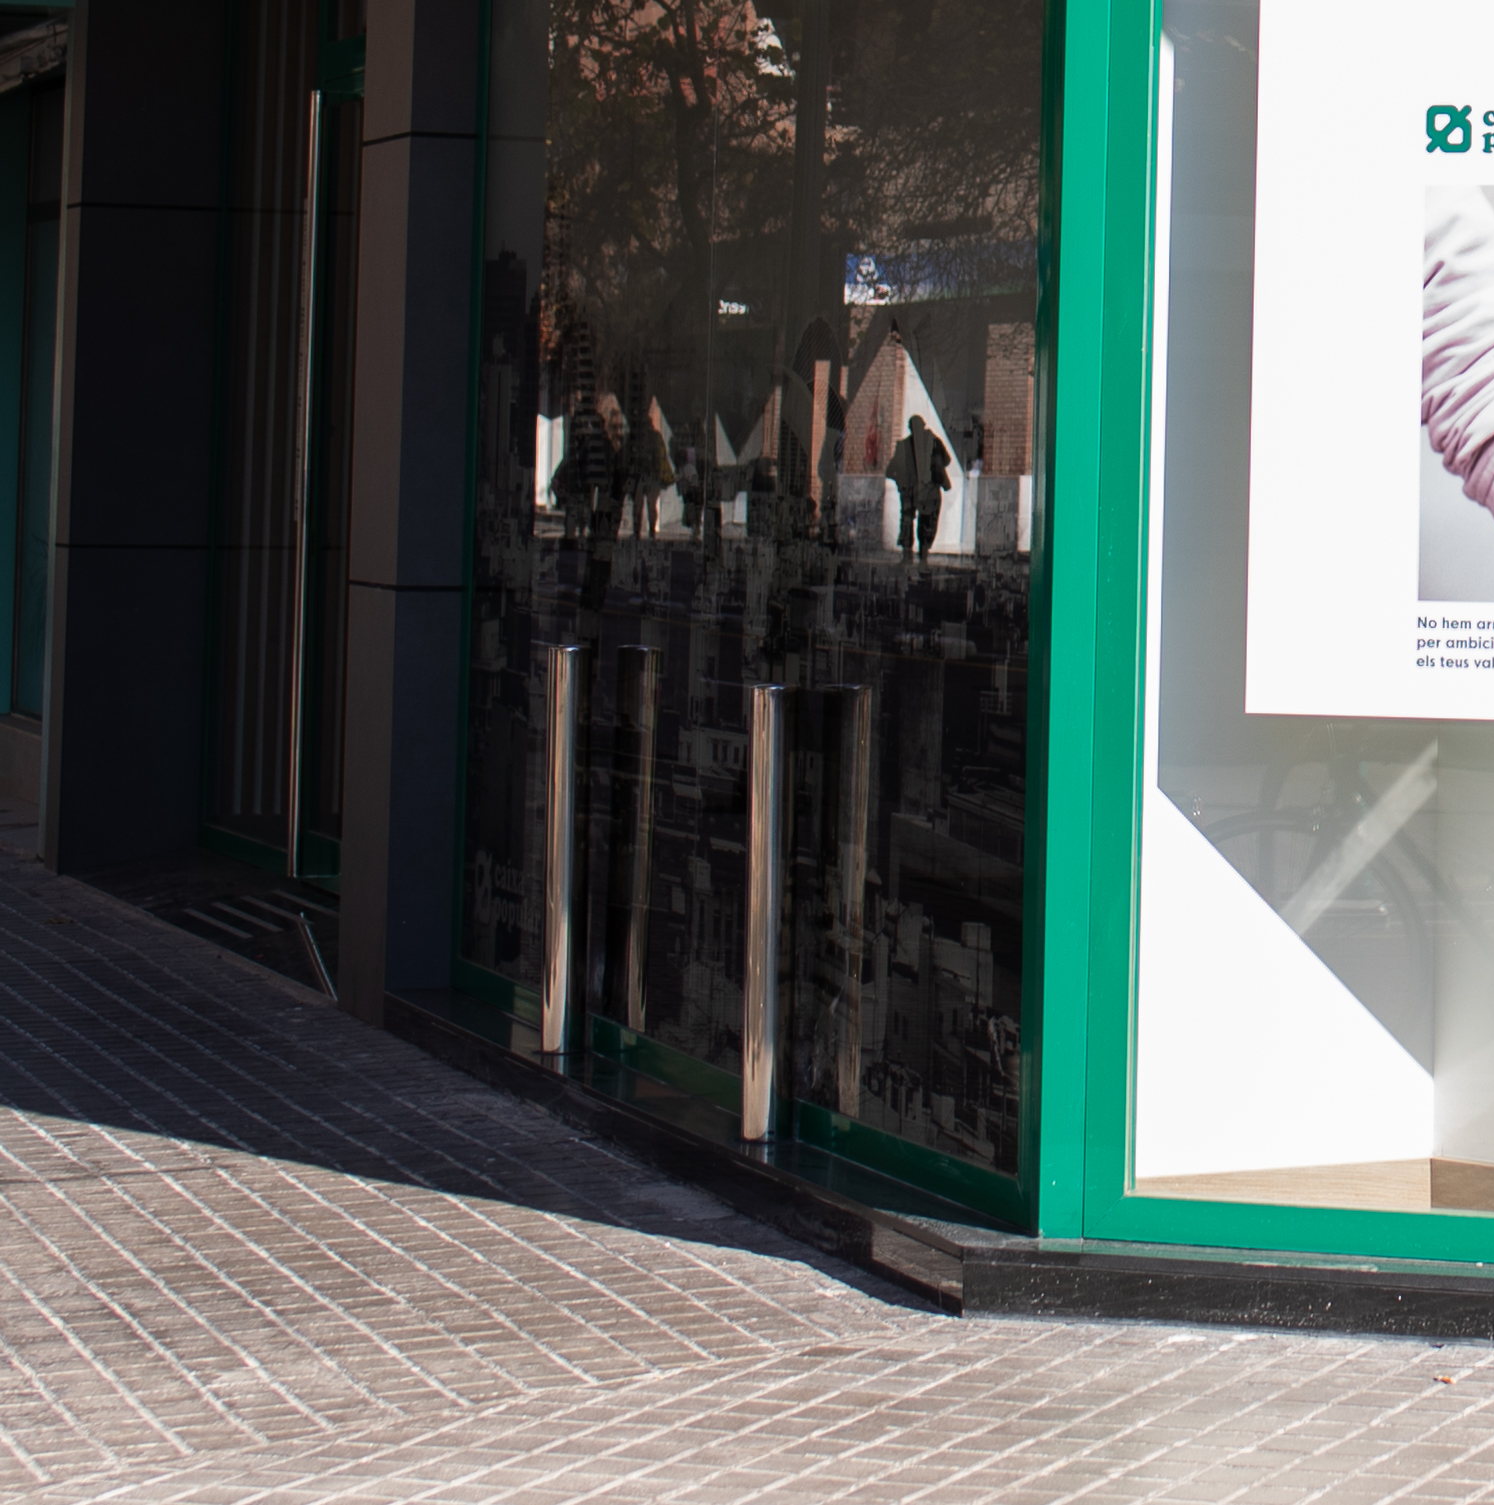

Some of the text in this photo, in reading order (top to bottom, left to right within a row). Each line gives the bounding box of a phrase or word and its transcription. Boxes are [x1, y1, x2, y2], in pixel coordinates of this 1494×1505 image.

[1417, 616, 1438, 629] No
[1442, 616, 1472, 630] hem
[1416, 638, 1441, 651] per
[1416, 655, 1436, 668] els
[1440, 656, 1470, 669] teus
[494, 858, 526, 896] caixa
[491, 896, 542, 934] popular
